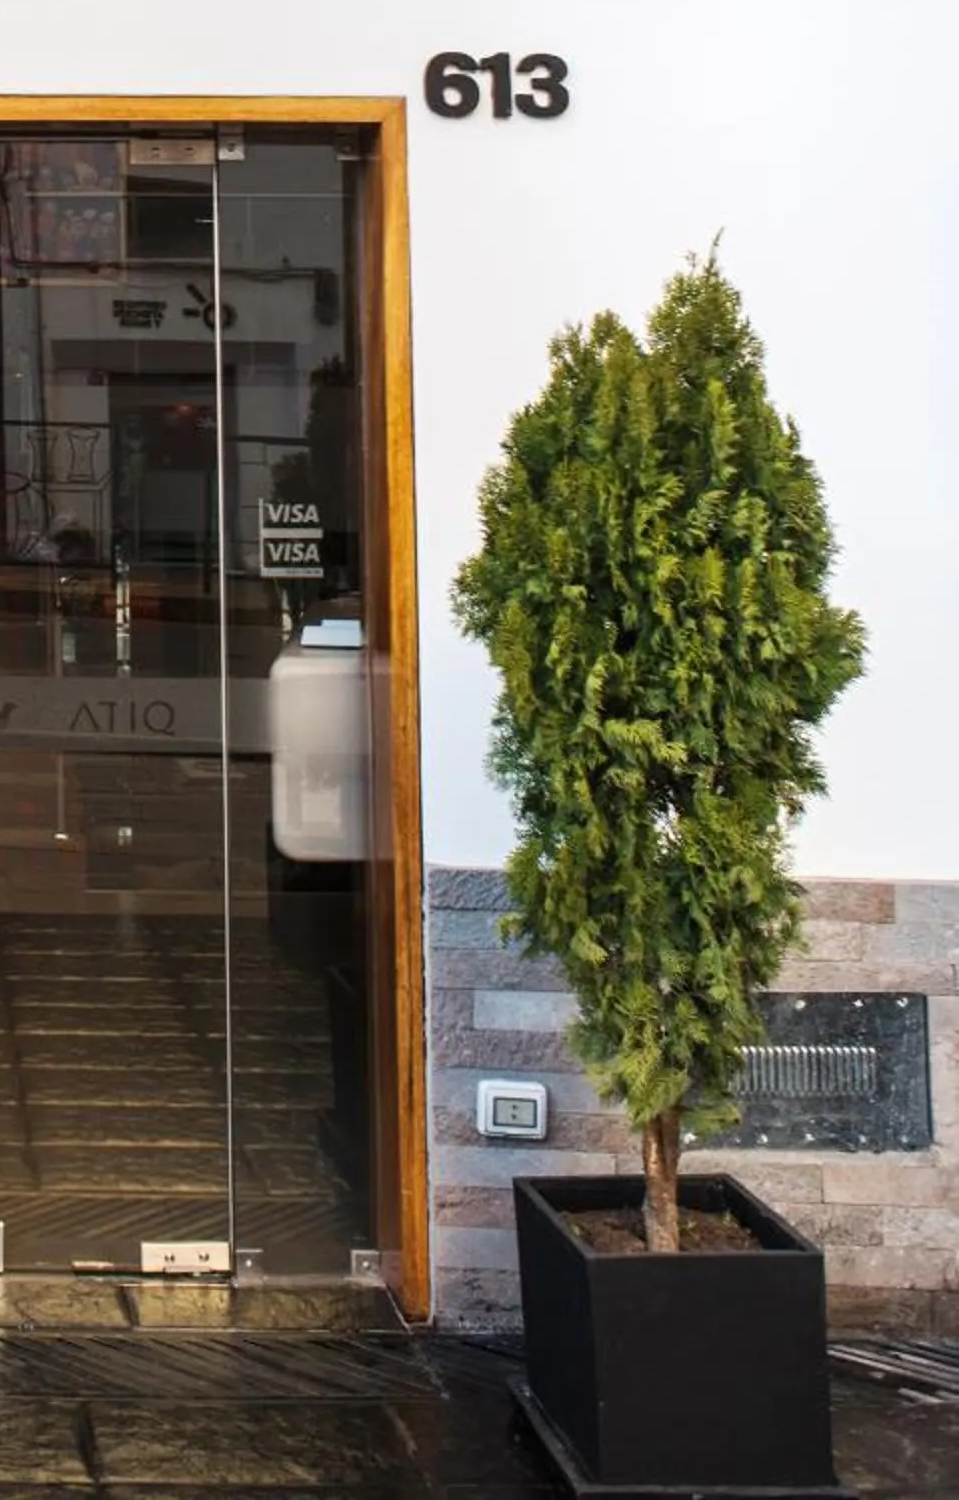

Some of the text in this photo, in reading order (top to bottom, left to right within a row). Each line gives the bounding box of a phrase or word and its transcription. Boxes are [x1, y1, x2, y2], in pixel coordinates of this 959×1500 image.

[424, 51, 570, 119] 613
[266, 503, 320, 523] VISA
[268, 543, 321, 563] VISA
[70, 700, 176, 735] ATIQ
